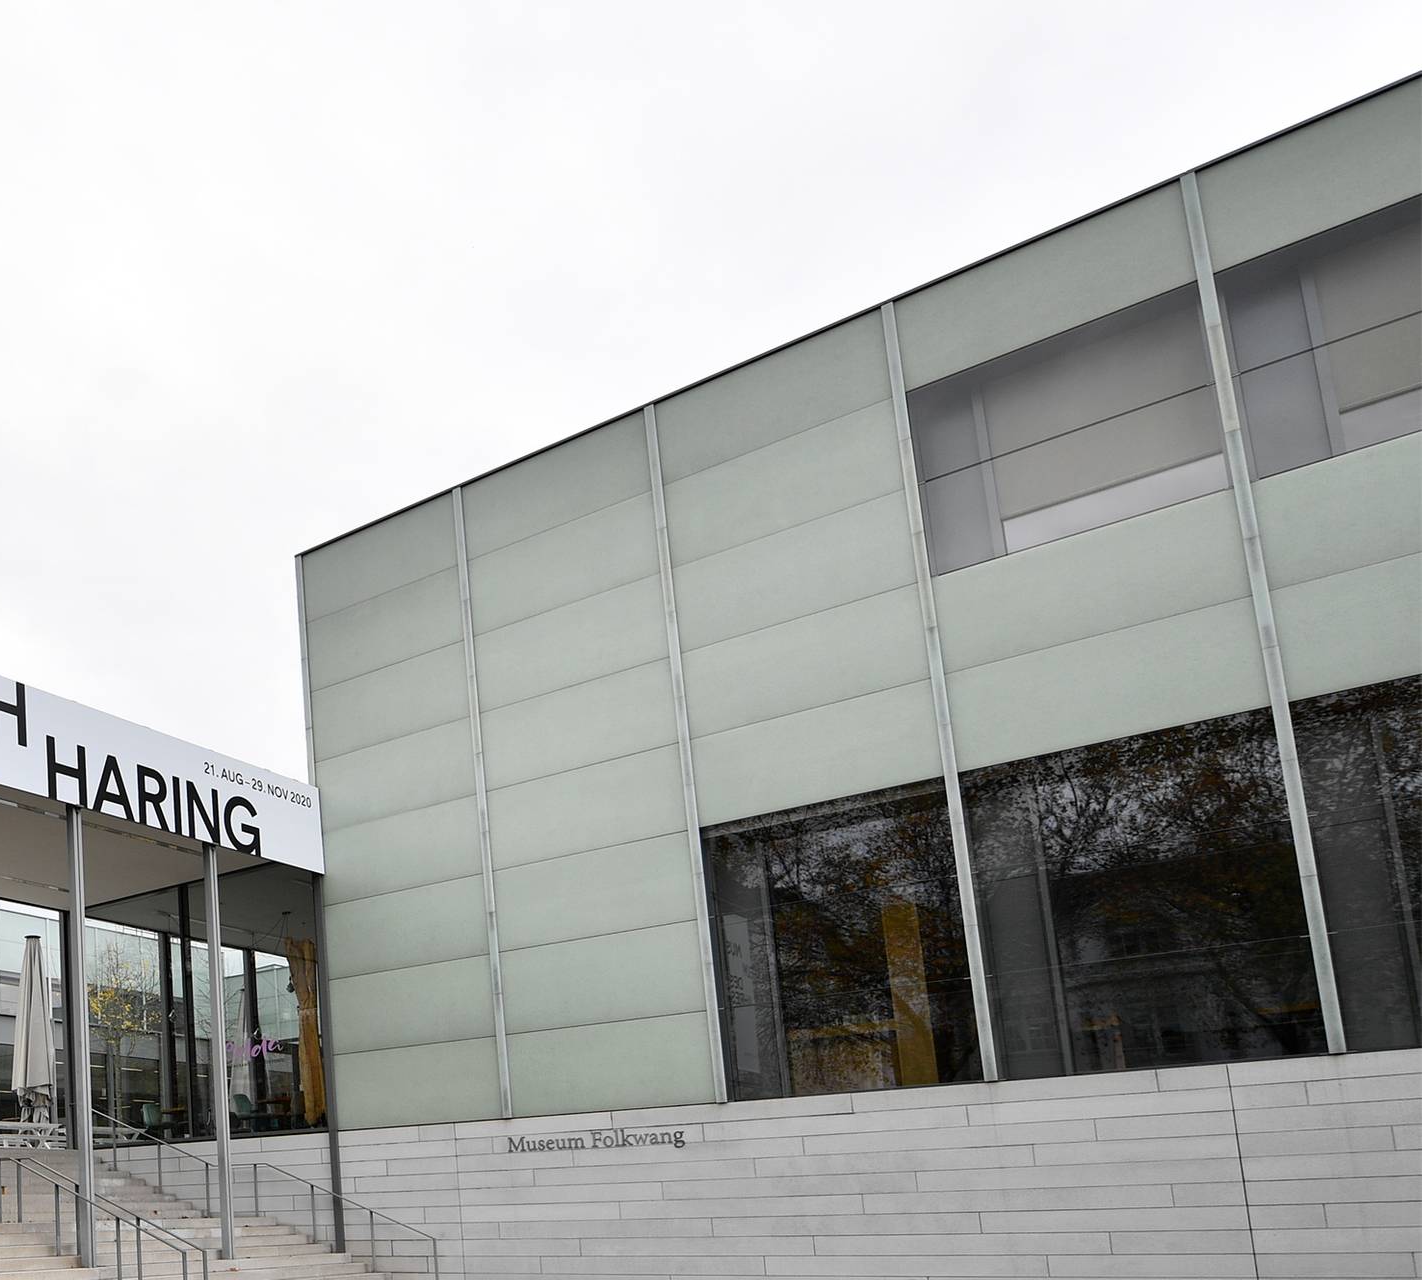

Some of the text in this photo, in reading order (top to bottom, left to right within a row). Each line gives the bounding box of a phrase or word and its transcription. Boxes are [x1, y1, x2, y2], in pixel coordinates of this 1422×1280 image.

[46, 734, 262, 857] HARING
[203, 761, 219, 778] 21.
[267, 783, 289, 801] NOV
[290, 791, 312, 809] 2020
[507, 1129, 685, 1153] Museum Folkwang
